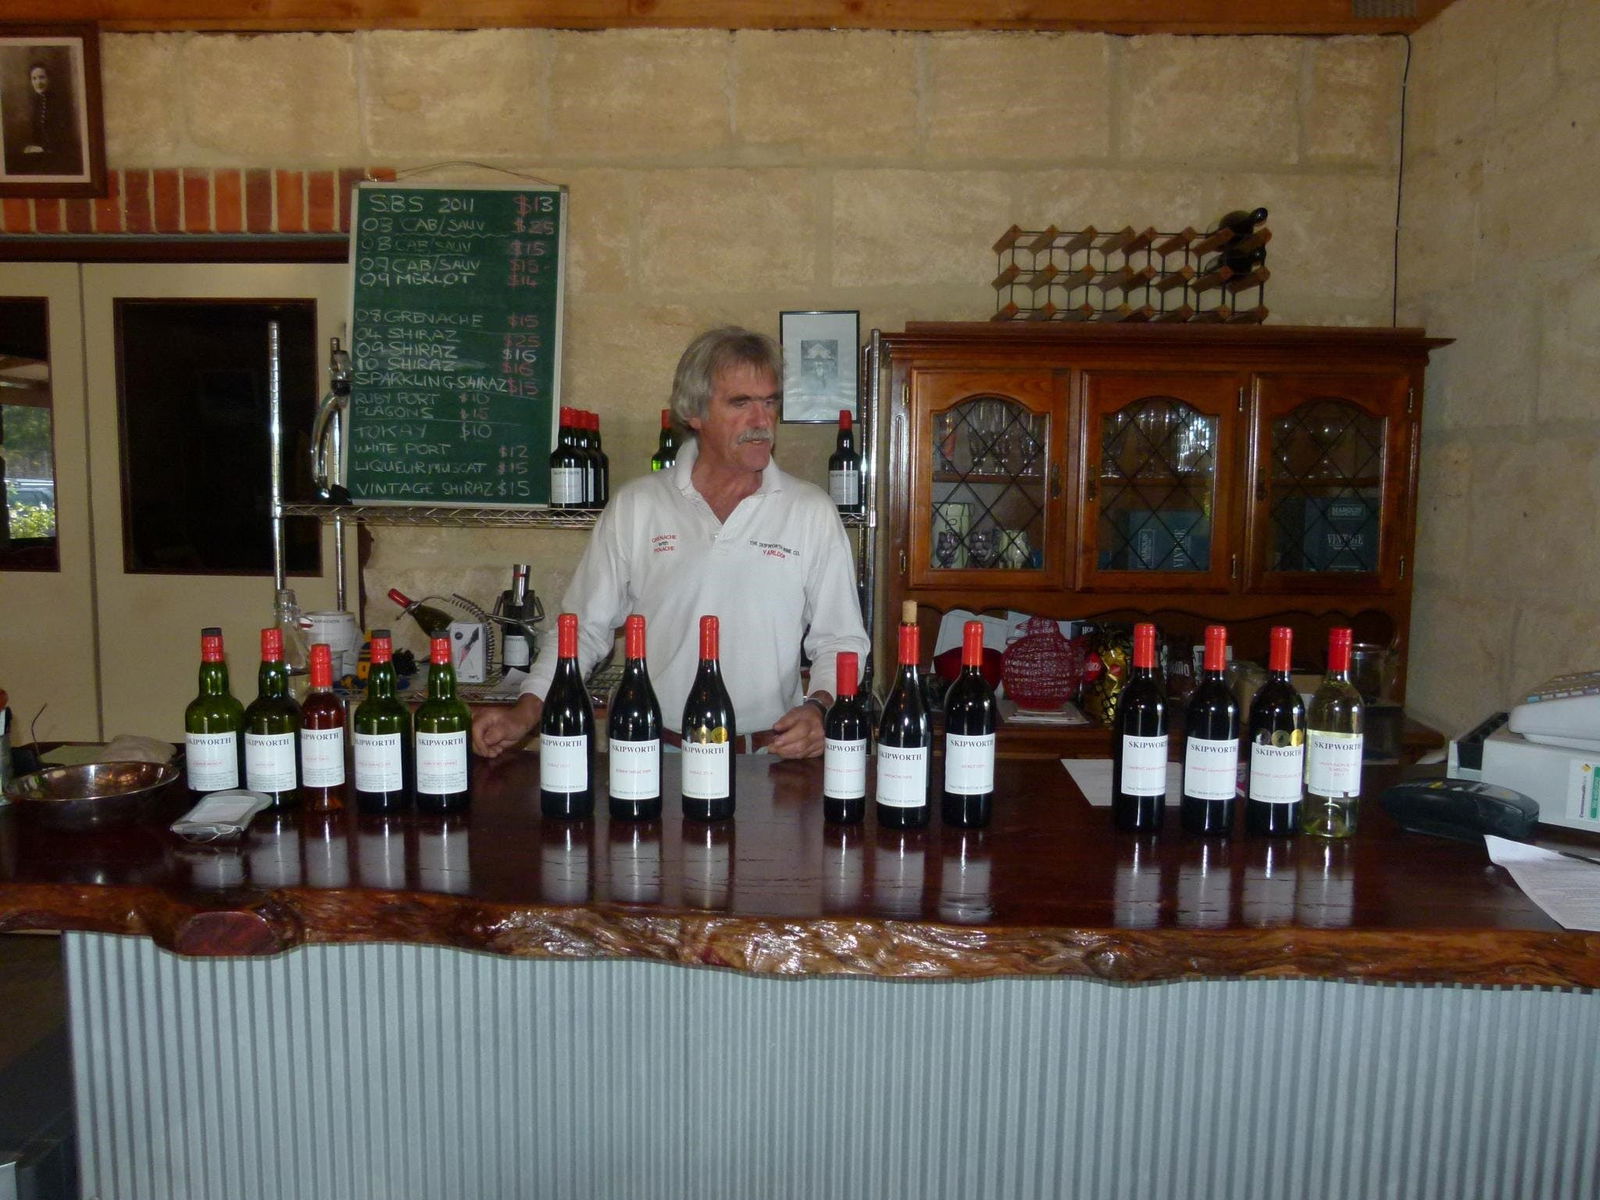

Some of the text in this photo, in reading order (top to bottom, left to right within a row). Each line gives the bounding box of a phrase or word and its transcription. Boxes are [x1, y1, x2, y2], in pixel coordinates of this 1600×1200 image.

[369, 194, 424, 212] SBS
[438, 197, 474, 213] 2011
[384, 310, 483, 327] GRENACHE
[387, 328, 460, 342] SHIRAZ
[388, 341, 458, 359] SHIRAZ
[387, 358, 457, 372] SHIRAZ
[405, 443, 451, 455] PORT
[356, 482, 433, 496] VINTAGE
